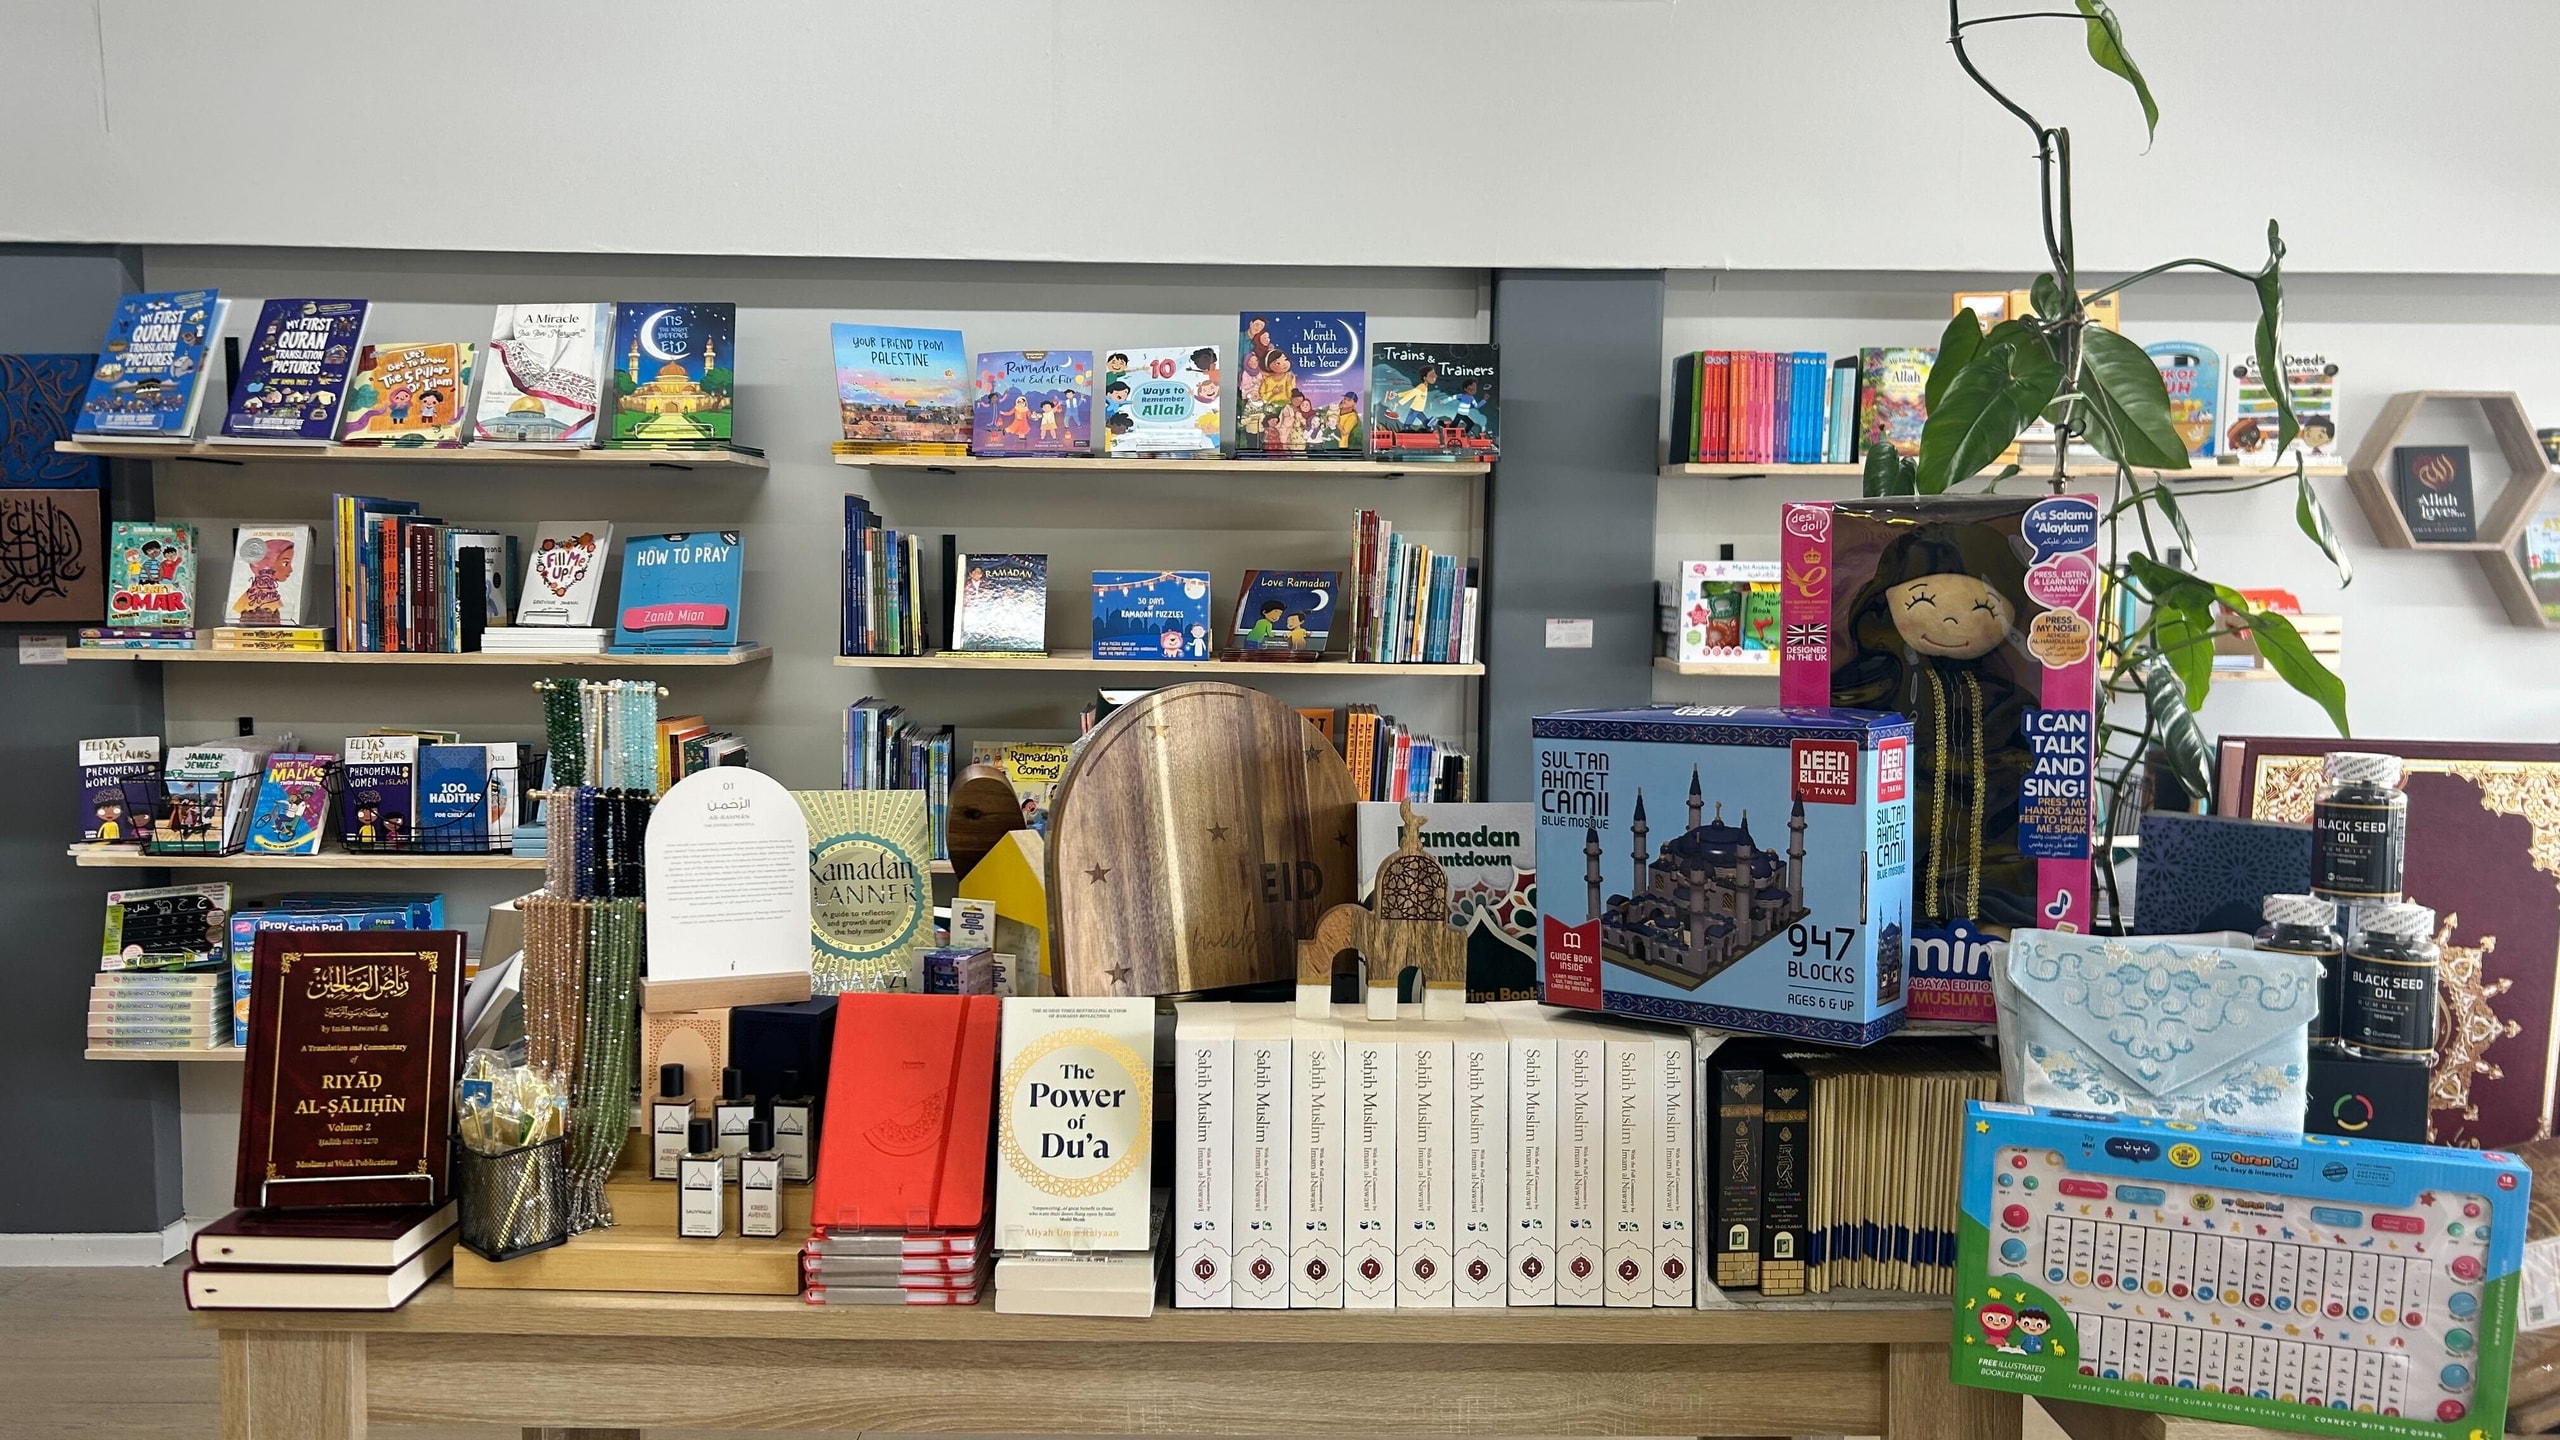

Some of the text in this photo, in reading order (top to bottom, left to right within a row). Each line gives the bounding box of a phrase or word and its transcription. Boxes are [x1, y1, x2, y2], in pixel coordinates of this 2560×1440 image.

[286, 318, 334, 331] MY FIRST
[524, 313, 580, 323] A Miracle
[1315, 321, 1326, 329] The
[278, 332, 328, 349] QURAN
[1303, 331, 1336, 341] Month
[276, 350, 324, 360] TRANSLATION
[1292, 343, 1348, 354] that Makes
[387, 362, 405, 372] Get
[420, 357, 447, 365] Know
[871, 352, 929, 367] PALESTINE
[1299, 357, 1340, 368] the Year
[1384, 346, 1425, 361] Trains
[1438, 363, 1494, 376] Trainers
[2285, 354, 2325, 366] Deeds
[271, 361, 321, 374] PICTURES
[1005, 361, 1060, 375] Ramadan
[1150, 359, 1176, 379] 10
[379, 366, 450, 389] The 5 Pillars
[1012, 376, 1026, 384] and
[1029, 375, 1044, 384] Eid
[1892, 371, 1920, 384] Allah
[423, 378, 453, 391] Islam
[1143, 387, 1170, 395] Ways
[1142, 405, 1185, 416] Allah
[2418, 493, 2458, 506] Allah
[1791, 513, 1815, 523] desi
[2032, 510, 2092, 520] As Salamu
[1801, 520, 1823, 531] doll
[2036, 522, 2088, 535] 'Alaykum
[547, 551, 585, 568] Fill Me
[637, 547, 729, 566] HOW TO PRAY
[553, 568, 573, 581] Up!
[985, 569, 1032, 579] RAMADAN
[128, 585, 173, 593] PLANET
[1261, 578, 1331, 588] Love Ramadan
[112, 591, 186, 612] OMAR
[644, 610, 704, 622] Zanib Mian
[1121, 610, 1184, 619] RAMADAN PUZZLES
[2026, 714, 2086, 732] I CAN
[350, 739, 384, 750] ELIYAS
[2032, 736, 2086, 753] TALK
[361, 751, 406, 763] EXPLAINS
[1010, 750, 1068, 763] Ramadan's
[1541, 751, 1609, 770] SULTAN
[1800, 750, 1849, 771] DEEN
[184, 761, 220, 769] JEWELS
[1018, 763, 1060, 778] Coming!
[2035, 757, 2085, 775] AND
[350, 767, 401, 777] PHENOMENAL
[1800, 770, 1849, 784] BLOCKS
[350, 778, 378, 787] WOMEN
[723, 782, 734, 790] 01
[1541, 771, 1609, 790] AHMET
[442, 783, 467, 793] 100
[1801, 787, 1847, 796] by TAKVA
[2024, 779, 2085, 797] SING!
[429, 793, 481, 804] HADITHS
[1541, 789, 1609, 817] CAMII
[1541, 816, 1609, 829] BLUE MOSQUE
[2318, 818, 2386, 833] BLACK SEED
[2338, 832, 2357, 843] OIL
[809, 850, 913, 885] Ramadan
[1260, 862, 1323, 903] EID
[830, 910, 849, 918] guide
[260, 920, 288, 931] iPray
[327, 923, 343, 932] Pad
[842, 919, 867, 927] growth
[870, 918, 891, 926] during
[847, 928, 862, 936] holy
[1787, 924, 1855, 961] 947
[1550, 952, 1593, 963] GUIDE BOOK
[1559, 962, 1584, 972] INSIDE
[1787, 961, 1854, 984] BLOCKS
[1788, 993, 1854, 1011] AGES 6 & UP
[1914, 991, 1978, 1006] MUSLIM
[308, 1044, 347, 1052] Translation
[363, 1043, 407, 1052] Commentary
[1060, 1064, 1094, 1079] The
[1030, 1083, 1126, 1107] Power
[1068, 1114, 1086, 1129] of
[1197, 1092, 1213, 1142] Muslim
[329, 1123, 371, 1132] Volume 2
[1041, 1133, 1109, 1158] Du'a
[2211, 1151, 2299, 1169] my Quran Pad
[1200, 1264, 1211, 1274] 10
[1312, 1265, 1320, 1274] 8
[1671, 1264, 1676, 1273] 1
[1978, 1358, 2045, 1373] FREE ILLUSTRATED
[1980, 1368, 2042, 1381] BOOKLET INSIDE!
[2315, 1416, 2446, 1439] CONNECT WITH THE QURAN.
